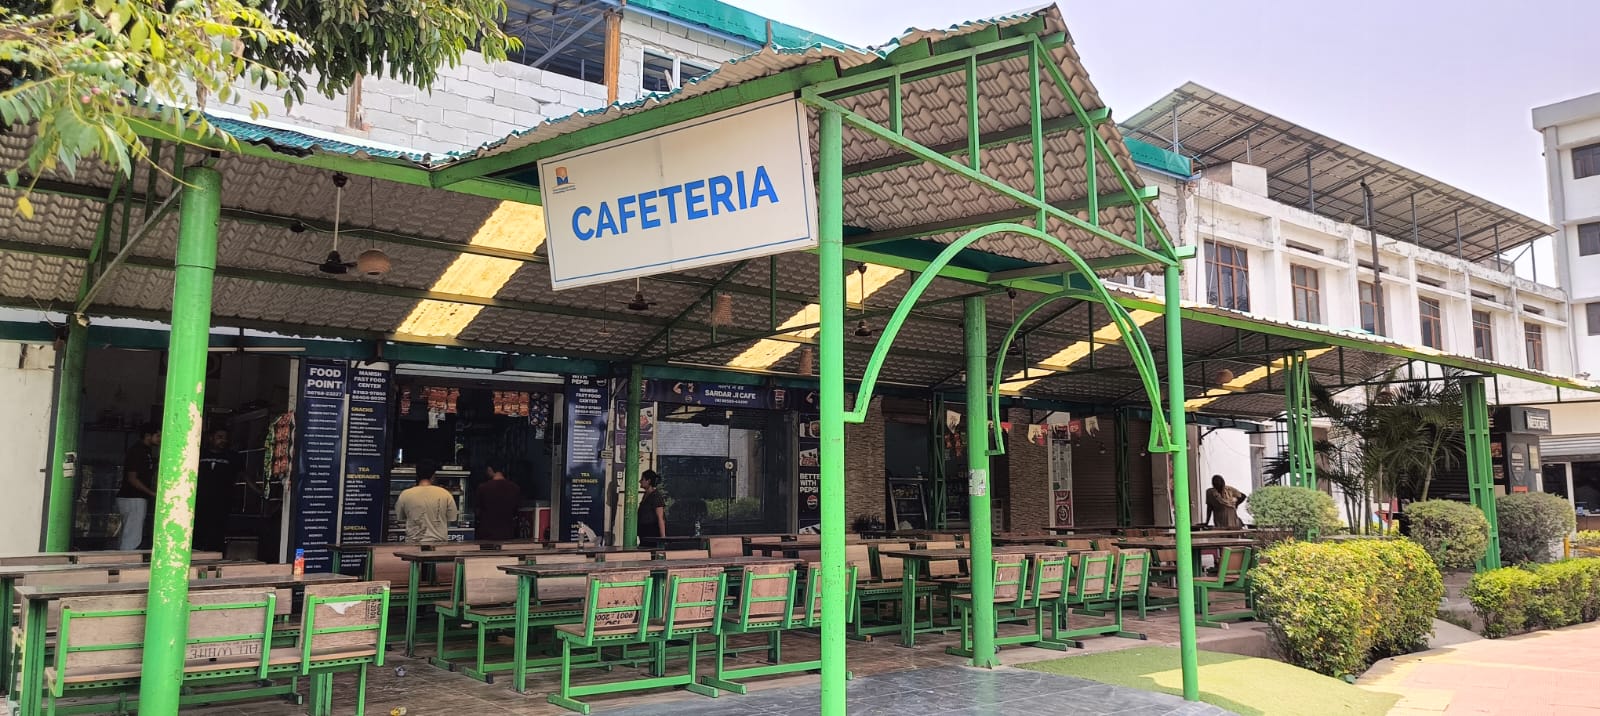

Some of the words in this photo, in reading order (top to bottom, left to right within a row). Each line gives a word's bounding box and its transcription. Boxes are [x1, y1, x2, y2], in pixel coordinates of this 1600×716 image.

[572, 165, 778, 241] CAFETERIA
[310, 368, 342, 378] FOOD
[307, 379, 343, 389] POINT
[704, 390, 732, 398] SARDAR
